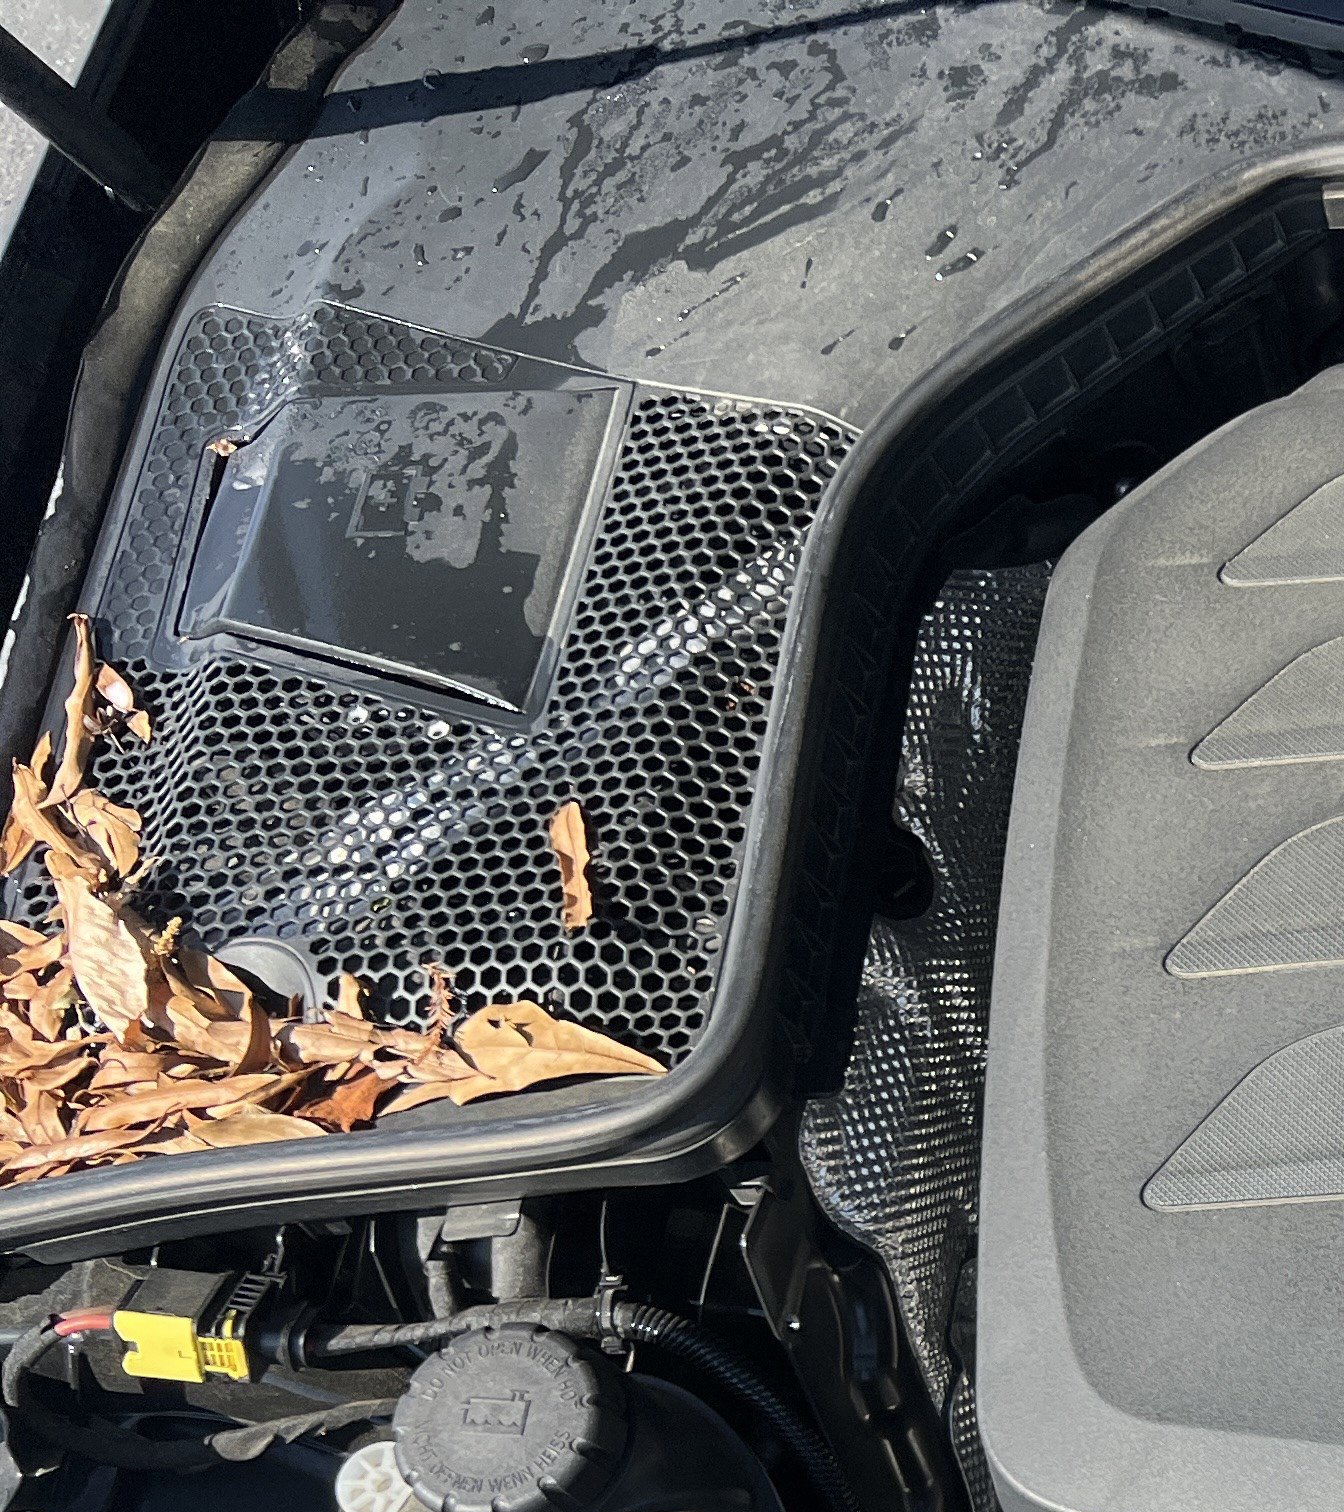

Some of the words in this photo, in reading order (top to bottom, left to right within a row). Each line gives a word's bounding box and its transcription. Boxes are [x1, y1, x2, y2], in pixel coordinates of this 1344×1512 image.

[421, 1377, 444, 1401] DO
[444, 1351, 472, 1380] NOT
[478, 1341, 522, 1359] OPEN
[526, 1343, 567, 1380] WHEN
[488, 1465, 535, 1494] WENN
[533, 1429, 571, 1471] HEISS
